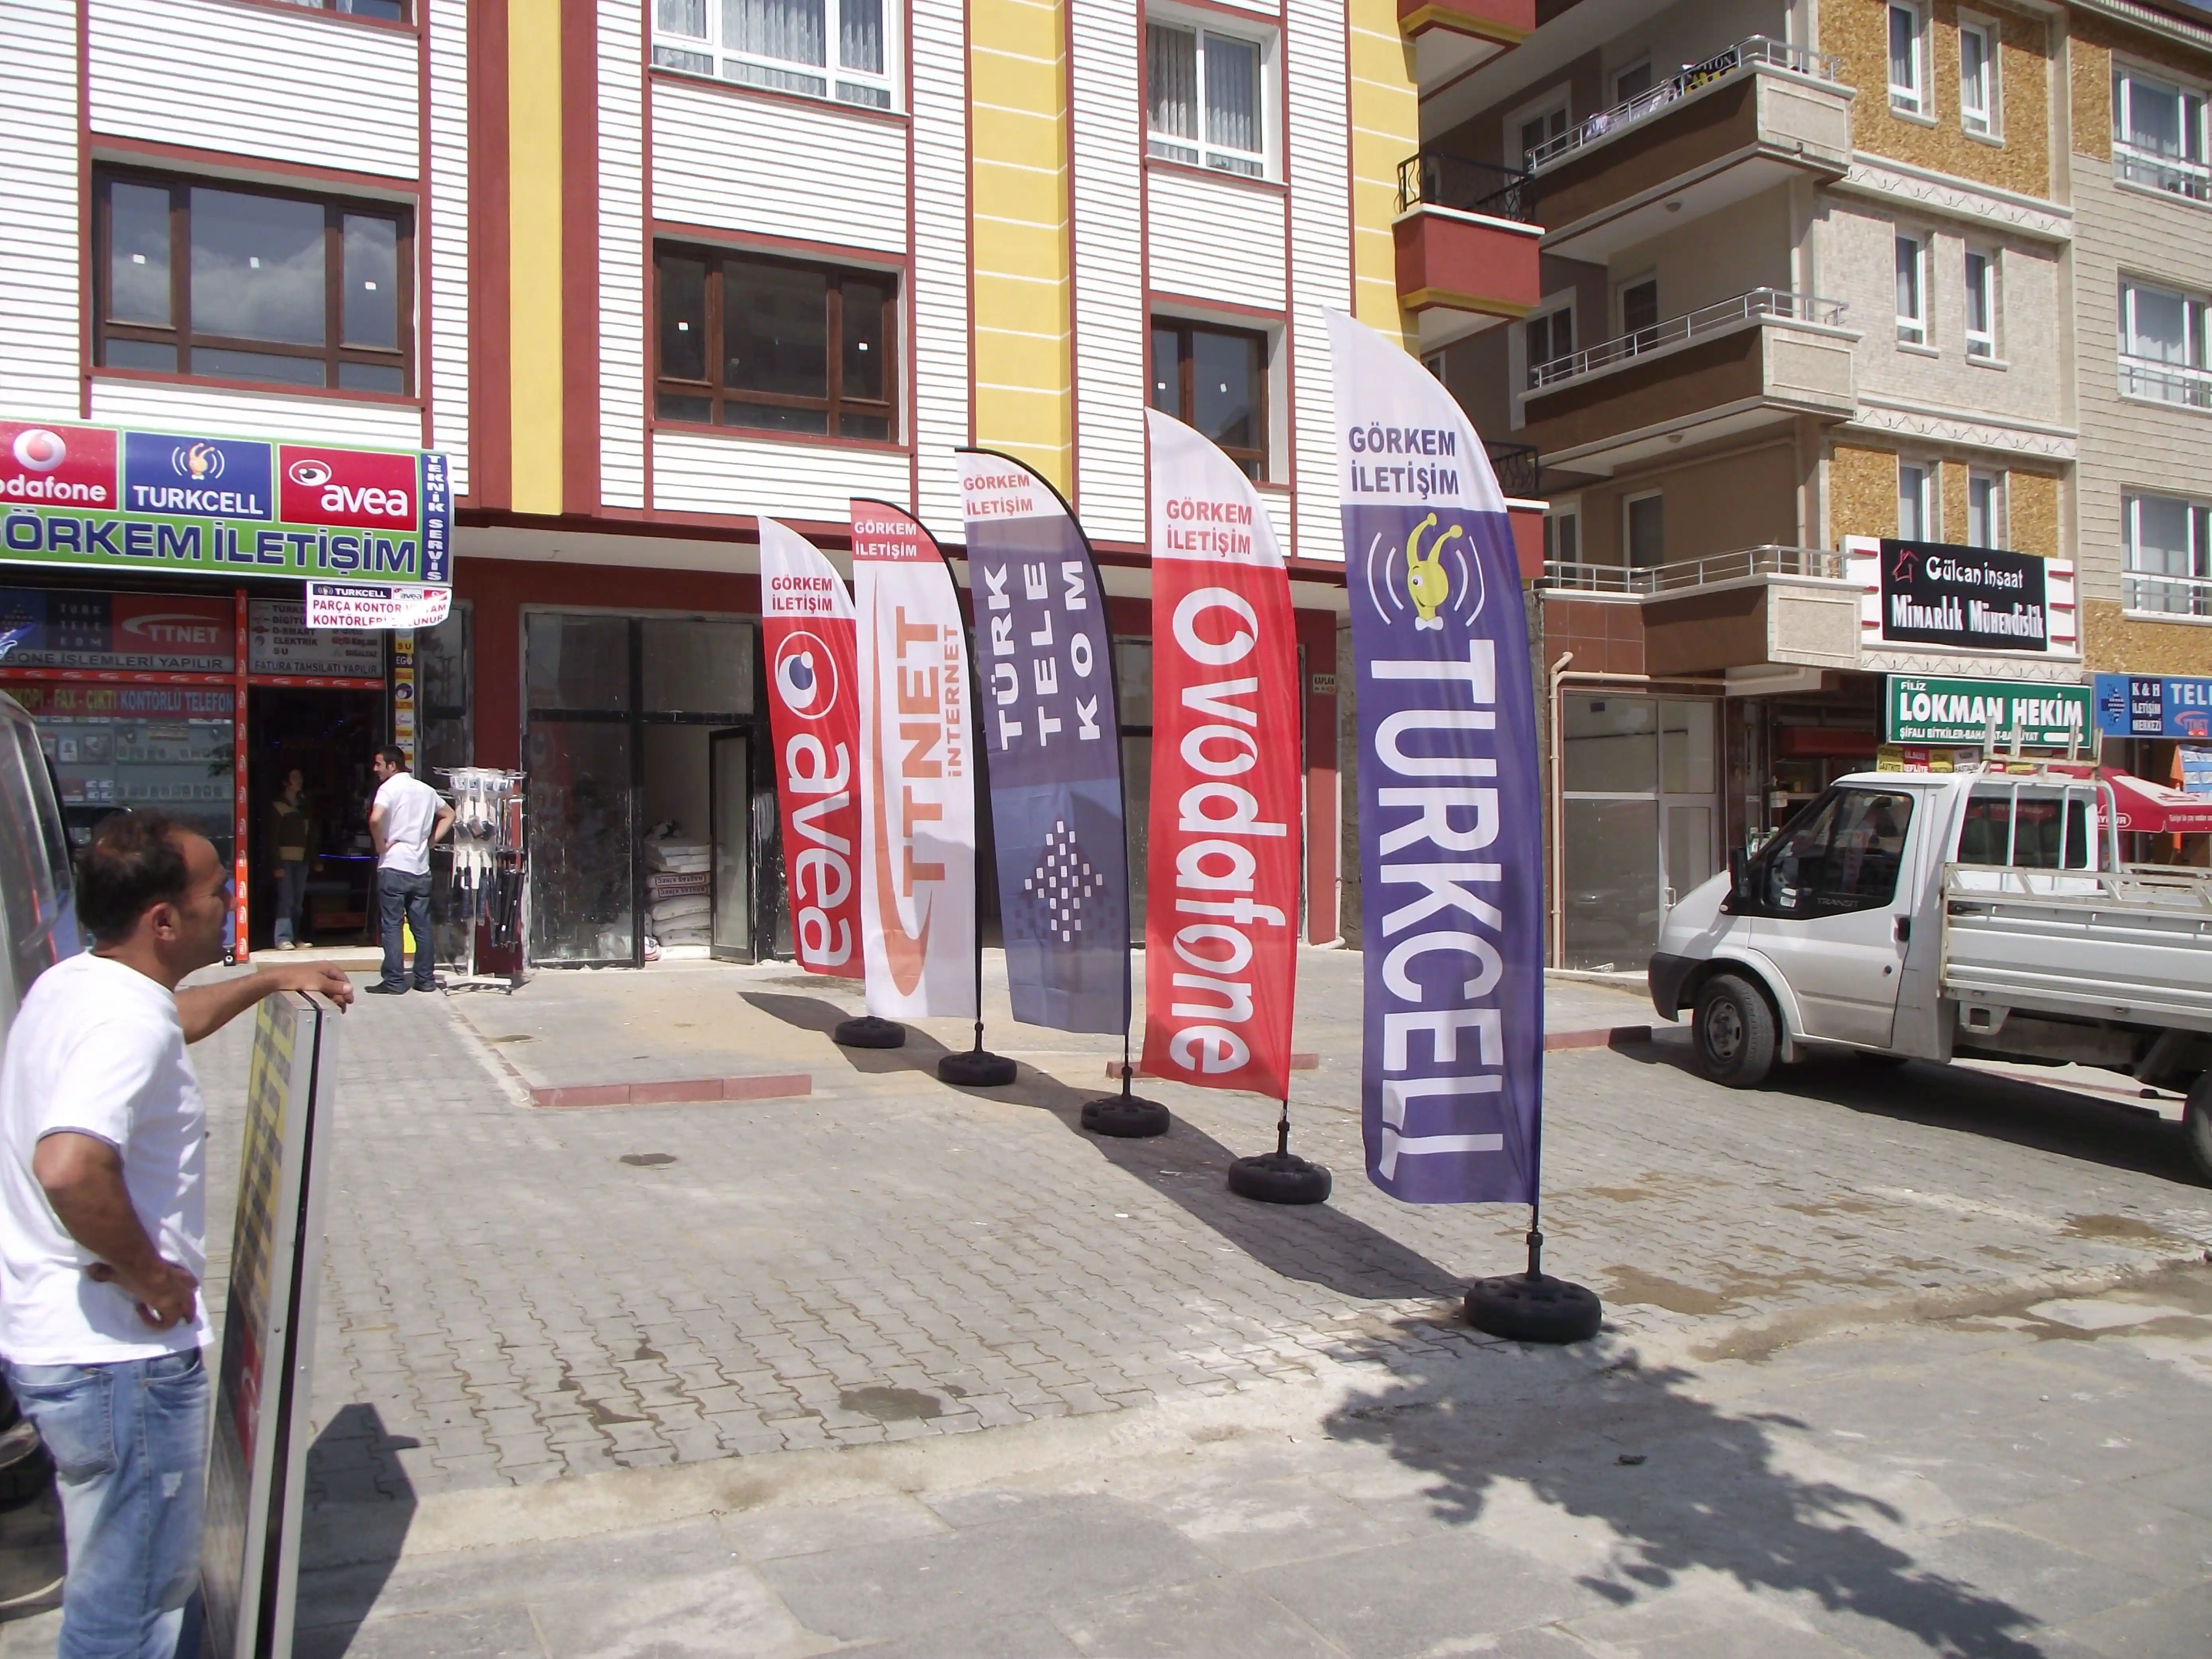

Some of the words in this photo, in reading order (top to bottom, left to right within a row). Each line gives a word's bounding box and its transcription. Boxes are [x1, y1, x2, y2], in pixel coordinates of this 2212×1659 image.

[1348, 422, 1456, 457] GÖRKEM
[0, 474, 107, 501] dafone
[427, 455, 445, 512] TEKNİK
[963, 473, 1030, 490] GÖRKEM
[1351, 460, 1459, 500] İLETİŞİM
[133, 485, 264, 515] TURKCELL
[321, 484, 409, 516] avea
[966, 498, 1033, 516] İLETİŞİM
[1167, 496, 1252, 525] GÖRKEM
[0, 509, 202, 560] ÖRKEM
[213, 521, 416, 575] İLETİŞİM
[854, 520, 917, 535] GÖRKEM
[1167, 524, 1251, 557] İLETİŞİM
[427, 519, 446, 581] SERVİS
[855, 541, 917, 559] İLETİŞİM
[771, 574, 832, 591] GÖRKEM
[1926, 556, 1981, 586] Gülcan
[313, 600, 351, 613] PARÇA
[355, 601, 402, 614] KONTÖR
[335, 588, 386, 597] TURKCELL
[772, 594, 832, 614] İLETİŞİM
[147, 625, 220, 643] TTNET
[0, 652, 55, 663] BONE
[160, 657, 223, 669] YAPILIR
[255, 660, 292, 672] FATURA
[984, 563, 1022, 750] TÜRK
[1023, 562, 1062, 746] TELE
[1061, 561, 1100, 741] KOM
[185, 691, 234, 711] TELEFON
[1901, 681, 1927, 691] FİLİZ
[1900, 692, 2003, 725] LOKMAN
[2012, 692, 2083, 727] HEKİM
[1899, 727, 1925, 739] ŞİFALI
[896, 606, 946, 897] TTNET
[786, 733, 852, 966] avea
[1169, 676, 1287, 1074] vodafone
[1371, 639, 1503, 1181] TURKCELL
